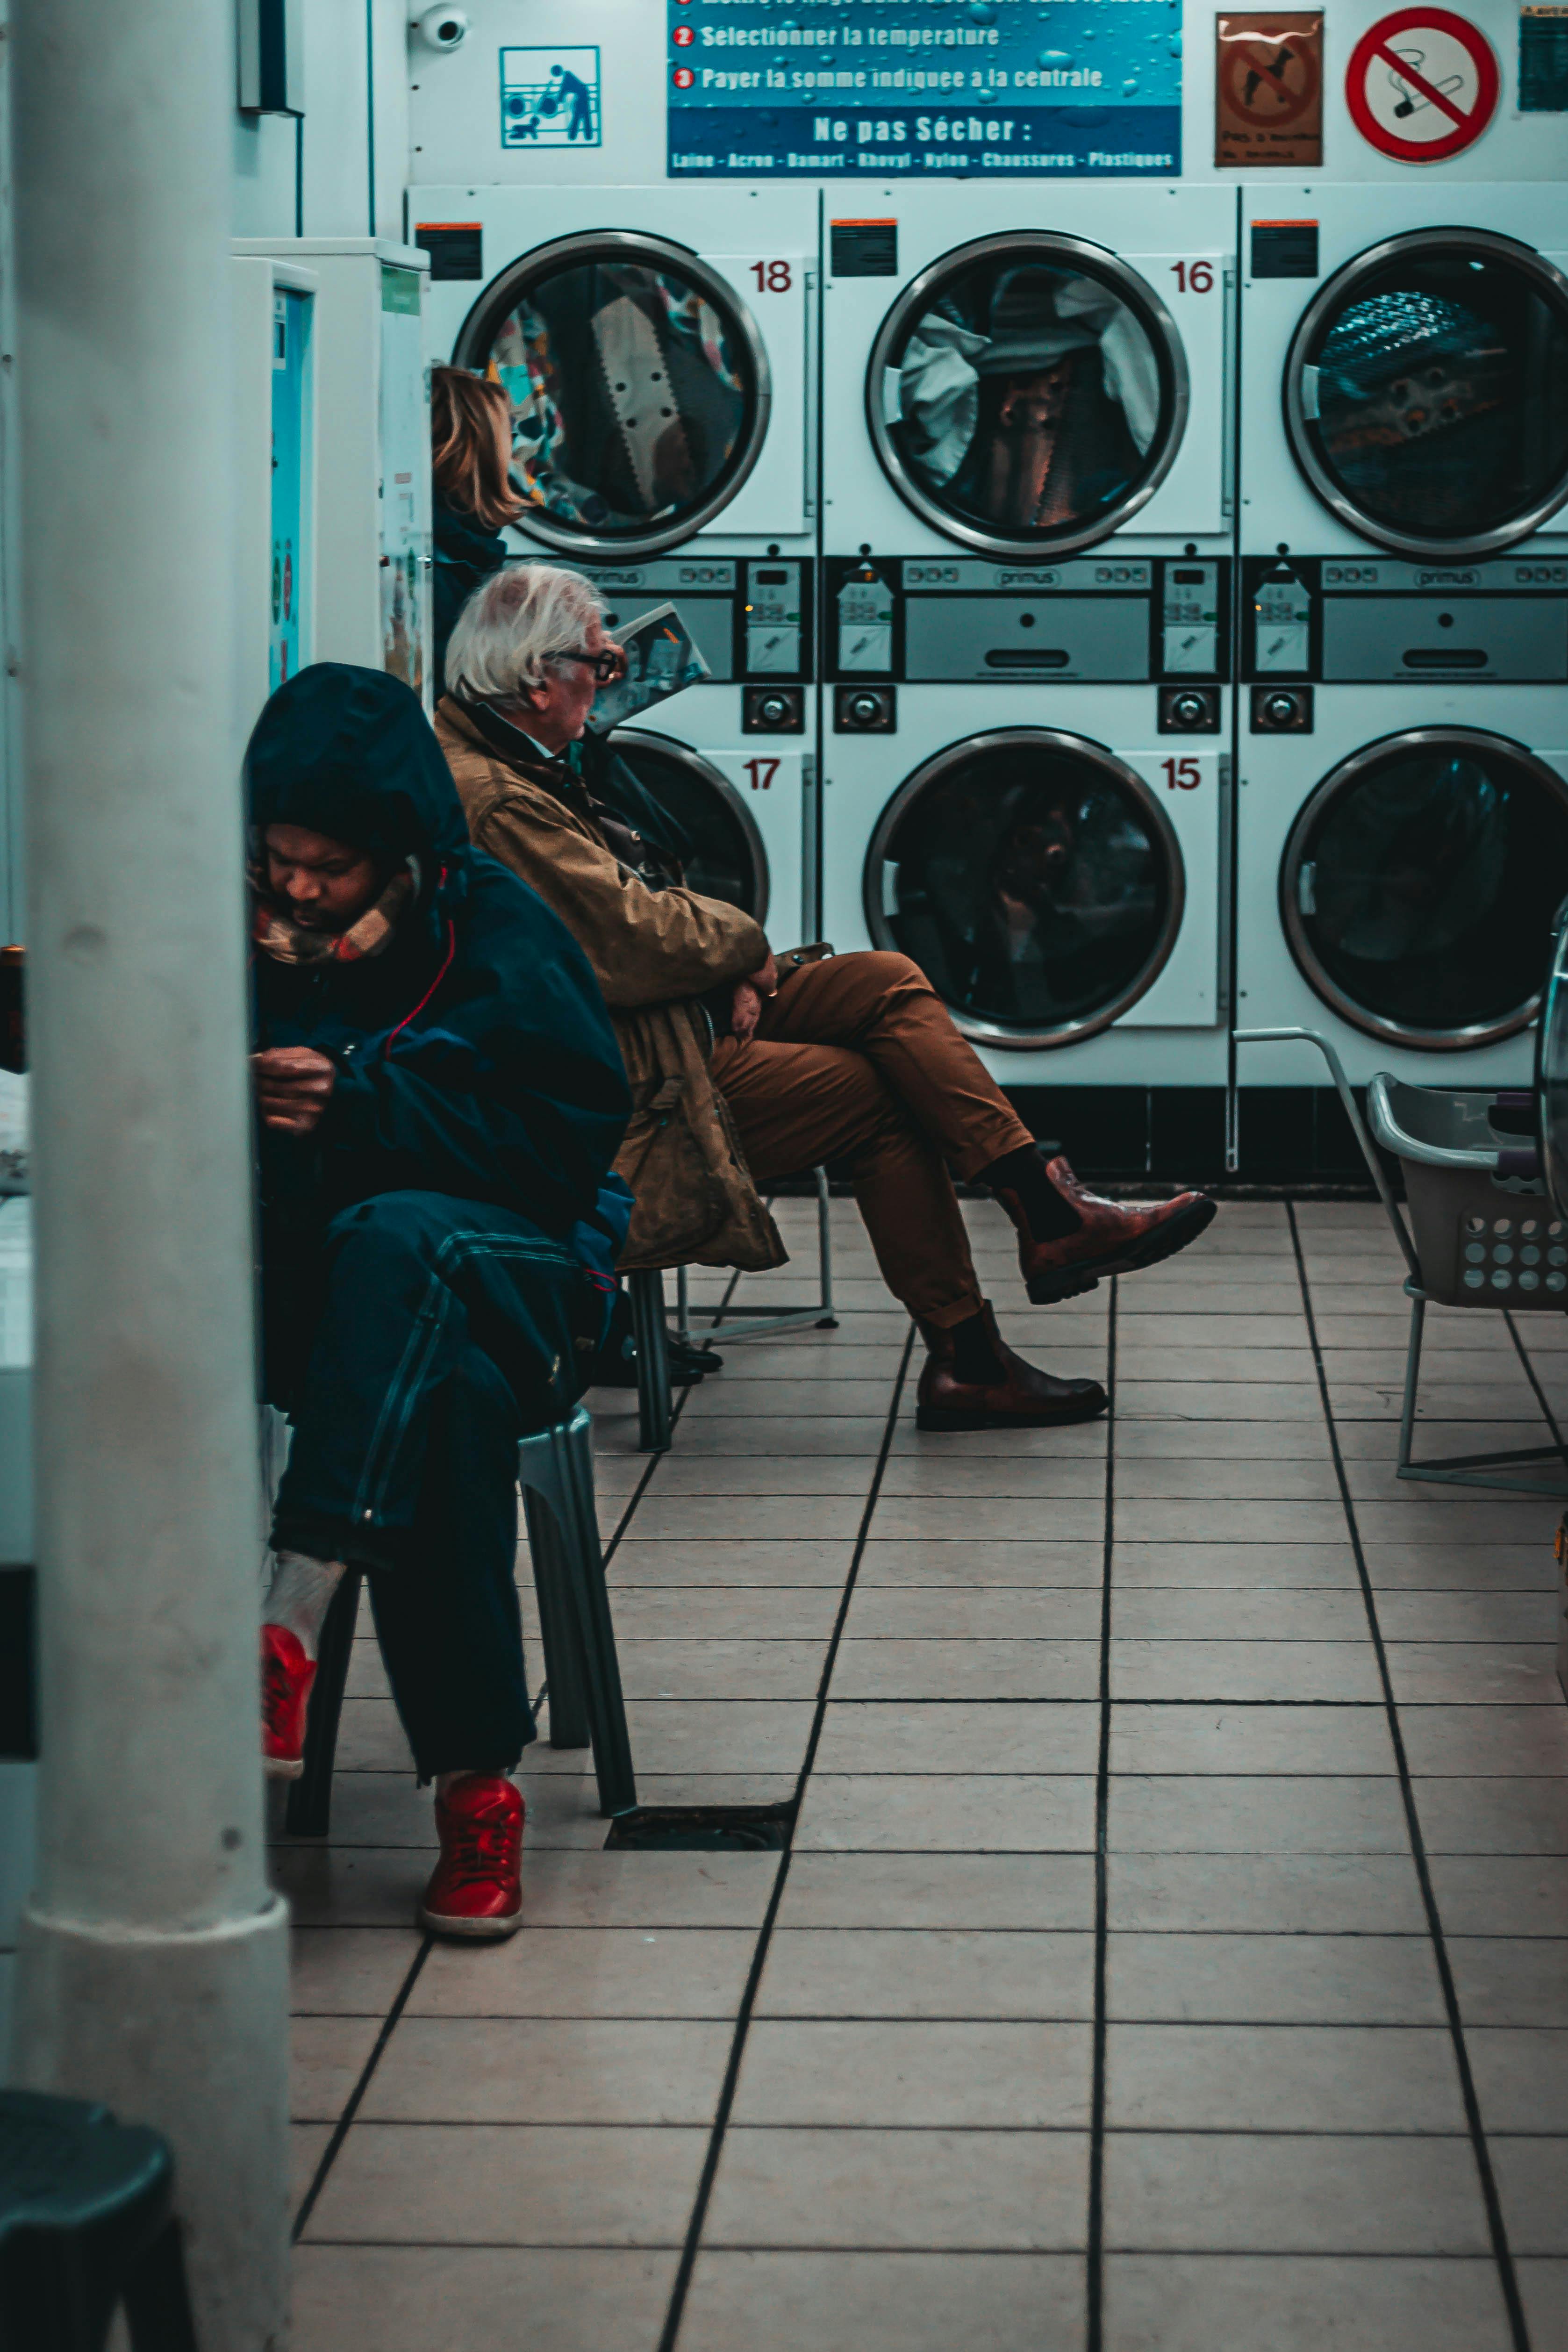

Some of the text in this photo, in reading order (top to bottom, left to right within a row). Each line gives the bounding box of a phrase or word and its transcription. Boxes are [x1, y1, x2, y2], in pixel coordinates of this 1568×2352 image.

[679, 28, 688, 44] 2
[843, 26, 862, 45] la
[679, 70, 688, 86] 3
[702, 68, 760, 90] Payer
[766, 69, 786, 87] la
[792, 72, 866, 87] somme
[988, 68, 1008, 87] la
[1014, 68, 1103, 87] centrale
[814, 117, 848, 141] Ne
[858, 121, 907, 143] pas
[916, 115, 1014, 141] Sécher
[982, 151, 1075, 167] Chaussures
[1088, 151, 1173, 168] Plastiques
[751, 260, 791, 293] 18
[1171, 260, 1213, 293] 16
[742, 758, 781, 789] 17
[1161, 758, 1201, 790] 15
